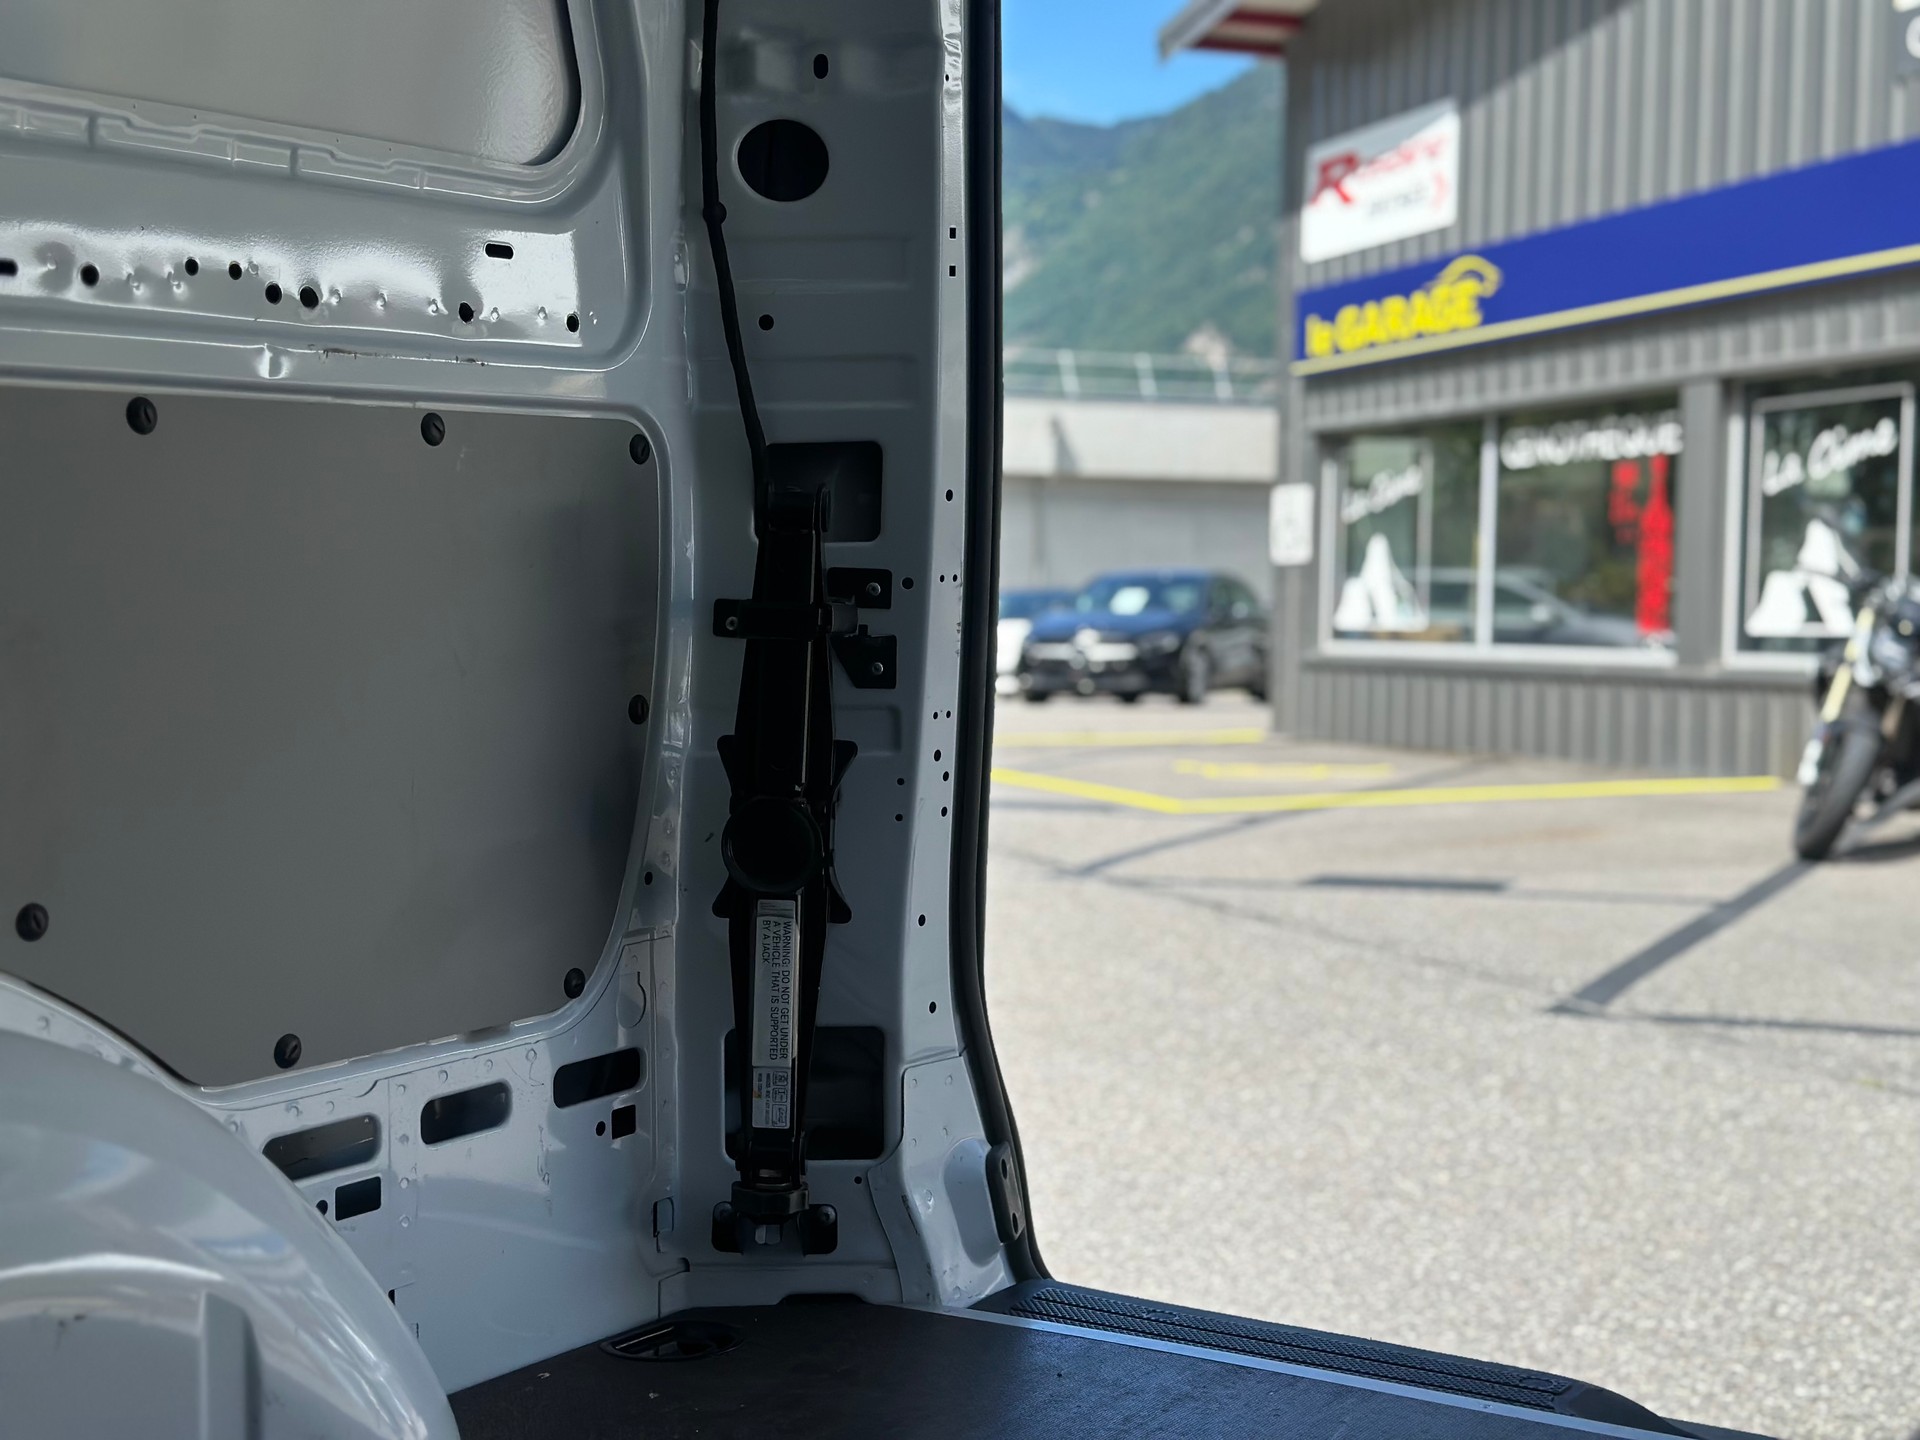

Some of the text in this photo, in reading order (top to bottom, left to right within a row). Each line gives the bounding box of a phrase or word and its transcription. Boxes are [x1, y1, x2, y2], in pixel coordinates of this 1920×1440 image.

[1334, 288, 1482, 352] GARAGE
[762, 920, 771, 931] BY
[762, 943, 770, 963] JACK
[771, 930, 780, 967] VEHICLE
[771, 971, 780, 992] THAT
[779, 921, 792, 1059] WARNING: DO NOT GET UNDER
[770, 995, 779, 1004] IS
[769, 1006, 779, 1061] SUPPORTED
